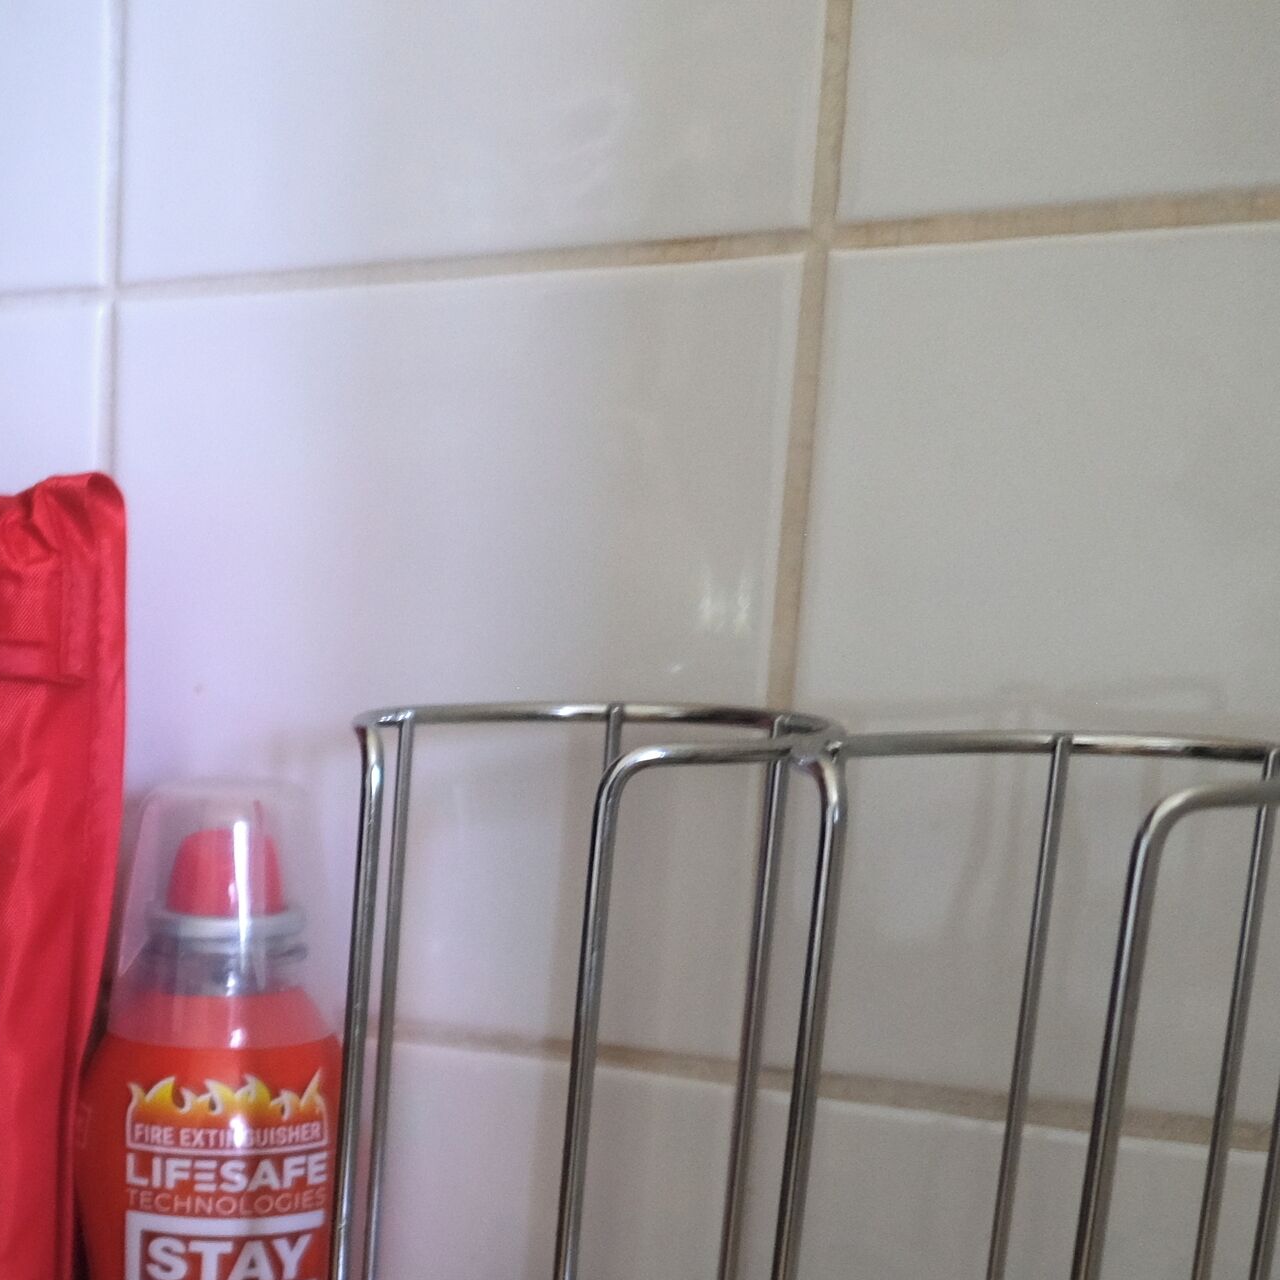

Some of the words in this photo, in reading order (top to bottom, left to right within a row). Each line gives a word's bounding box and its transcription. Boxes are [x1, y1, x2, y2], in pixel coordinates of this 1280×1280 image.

[133, 1122, 175, 1145] FIRE
[126, 1151, 329, 1194] LIFESAFE
[126, 1186, 327, 1216] TECHNOLOGIES
